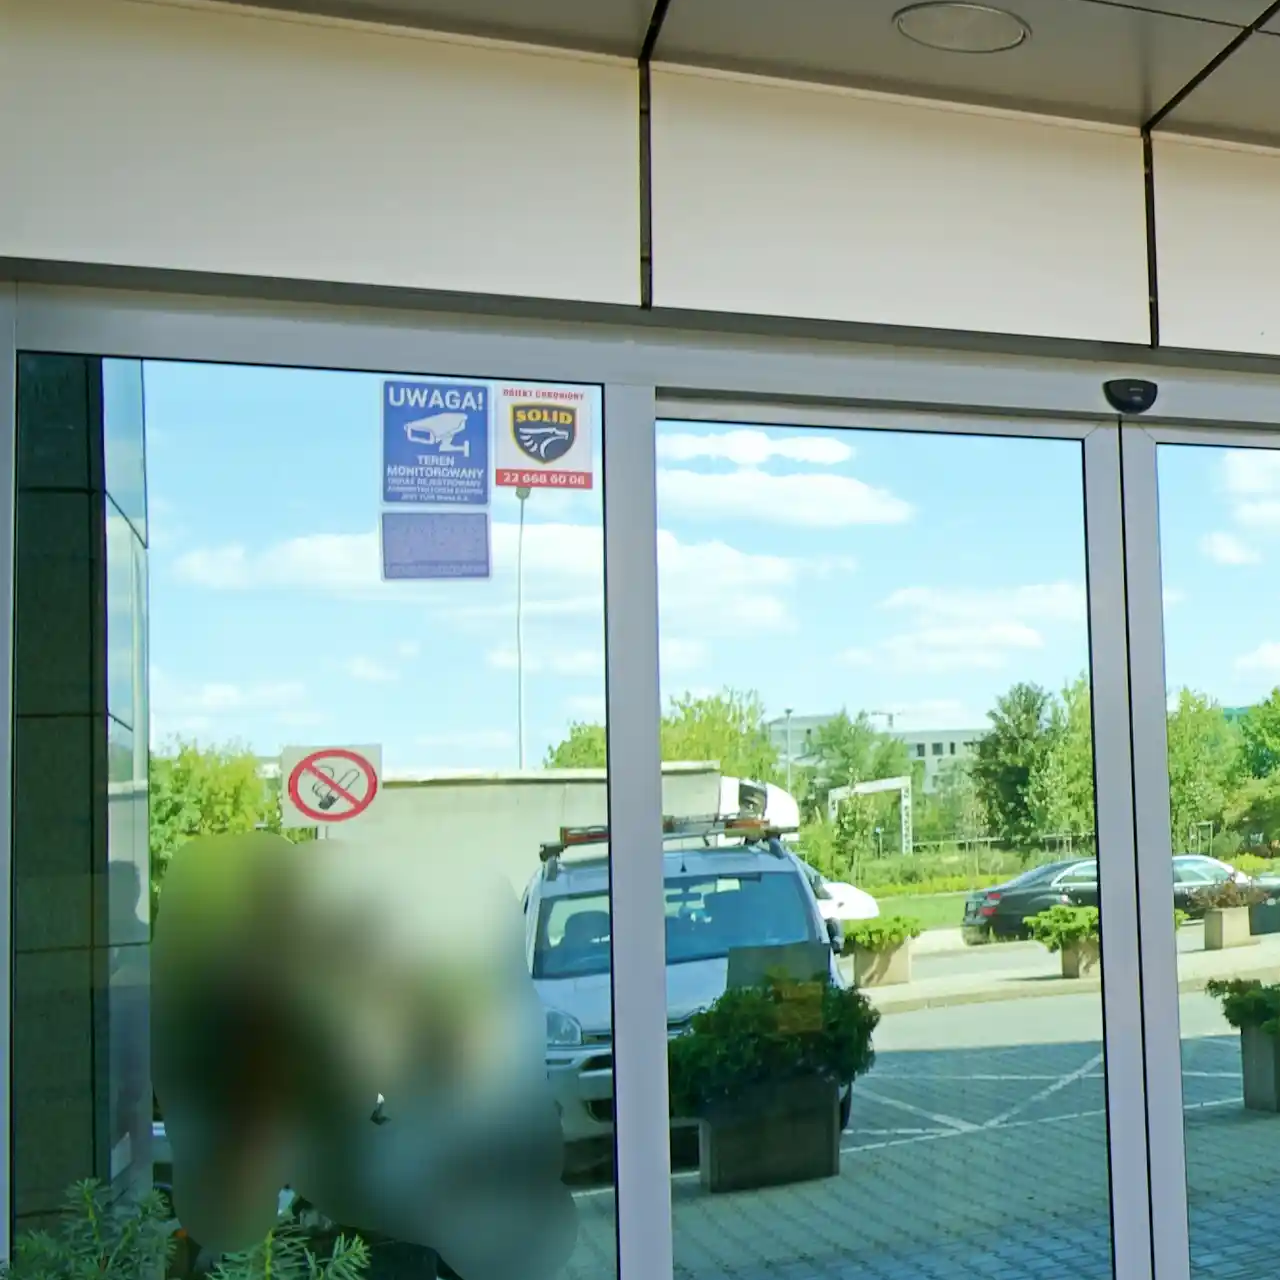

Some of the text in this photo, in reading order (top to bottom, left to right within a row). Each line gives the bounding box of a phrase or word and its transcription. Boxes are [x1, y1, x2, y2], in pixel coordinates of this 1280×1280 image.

[388, 386, 484, 411] UWAGA!
[515, 409, 573, 425] SOLID
[417, 454, 455, 467] TEREN
[387, 464, 484, 480] MONITOROWANY
[503, 472, 519, 483] 22
